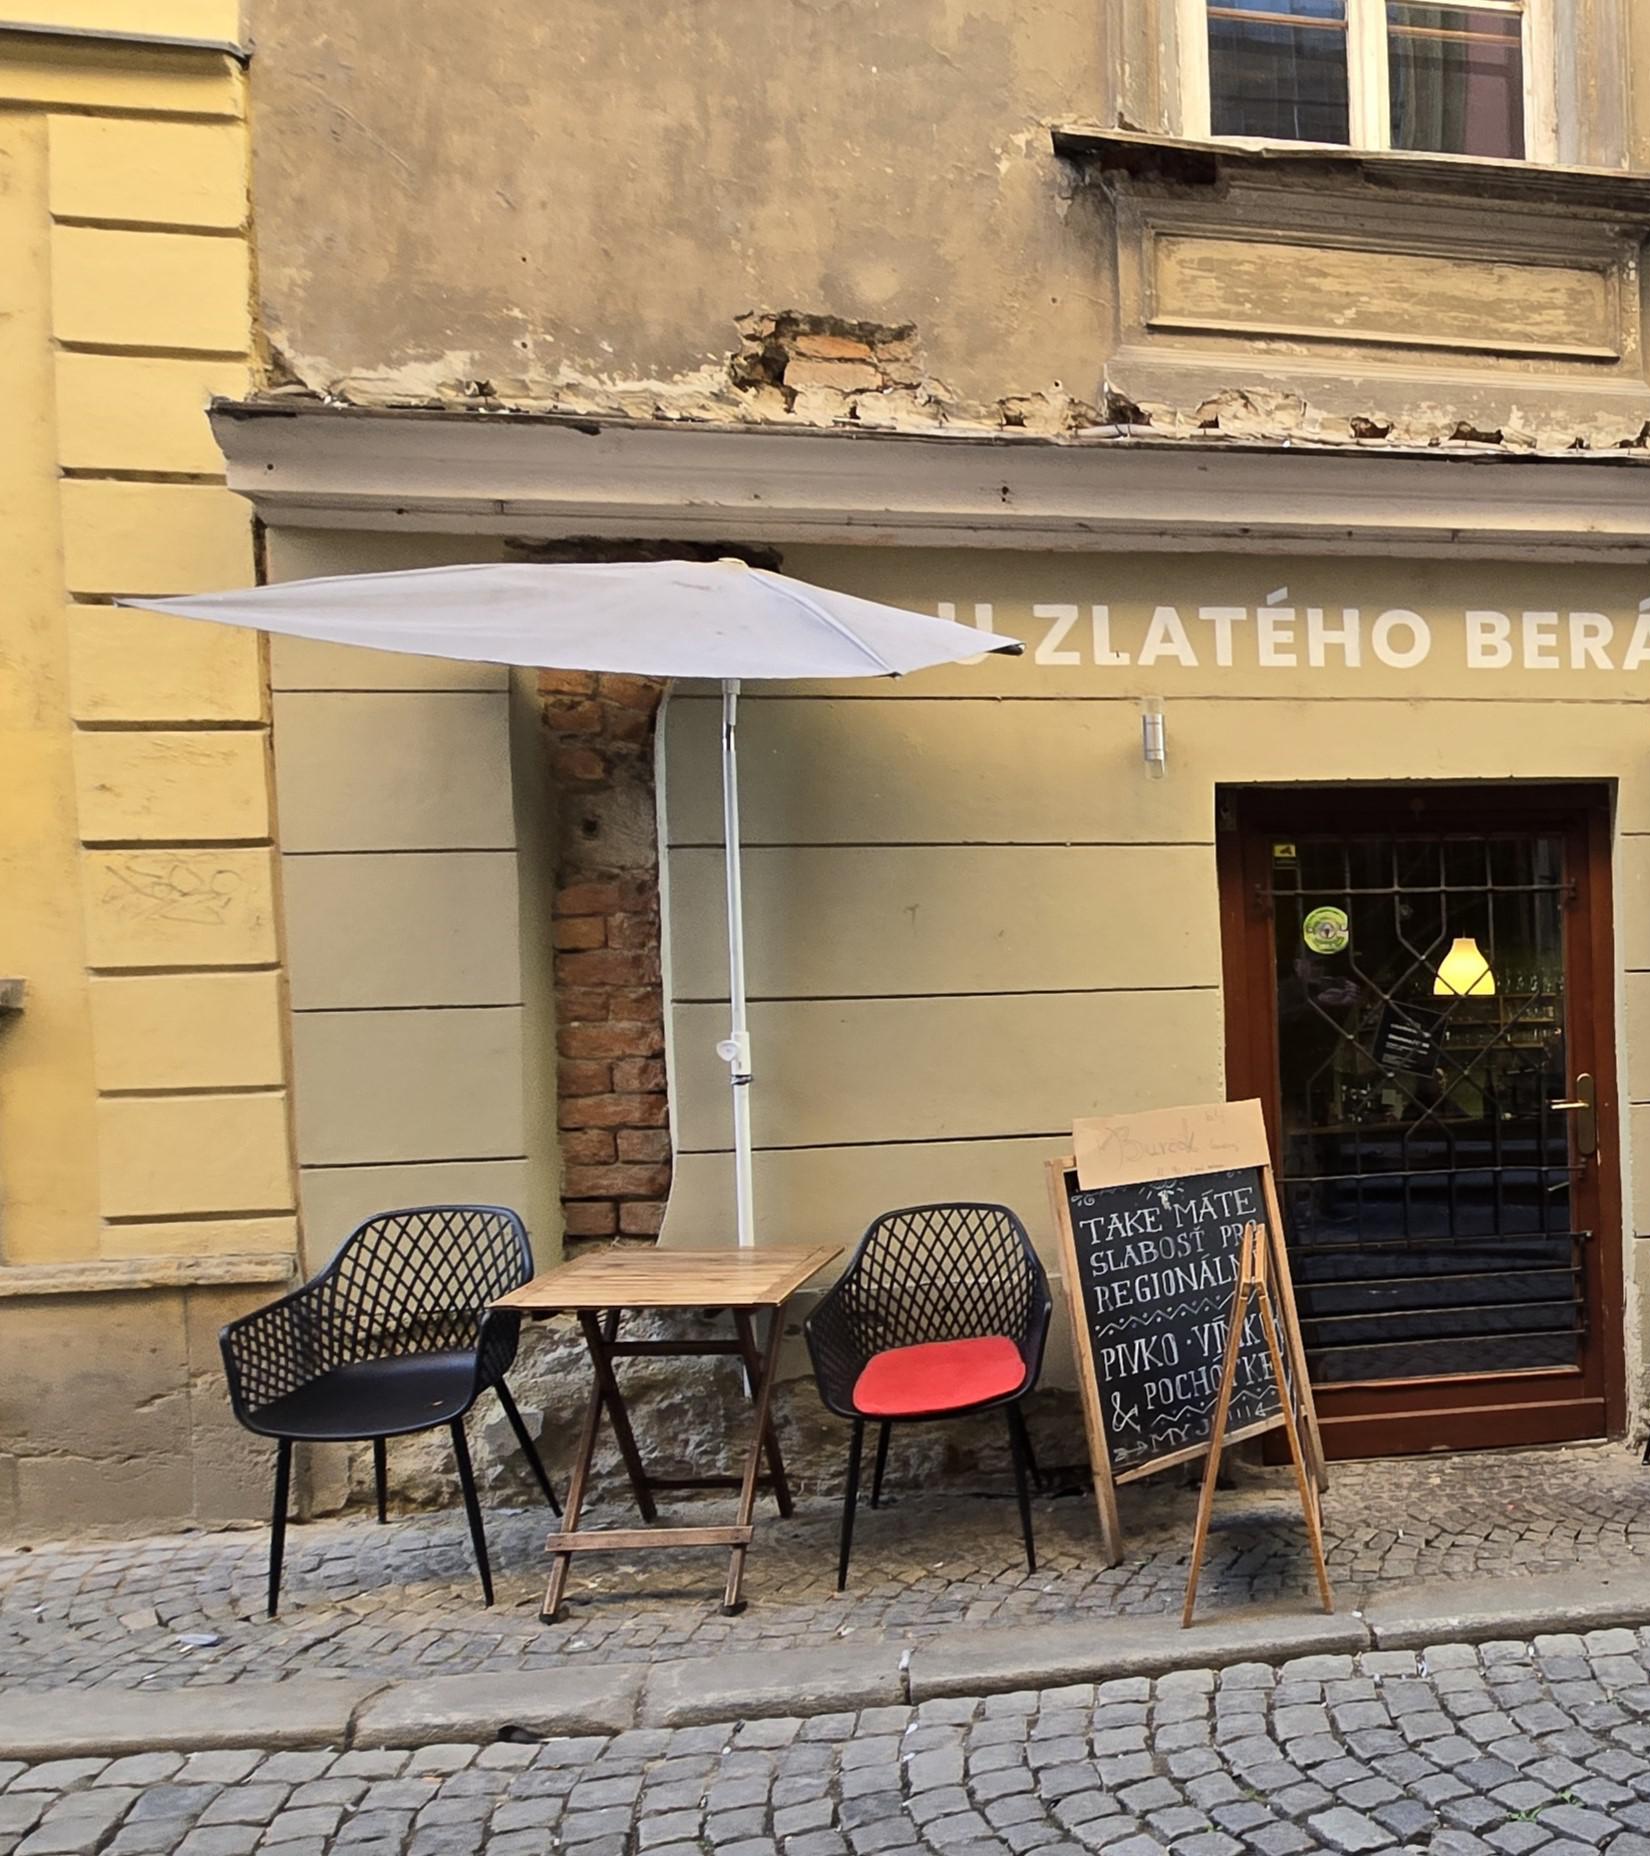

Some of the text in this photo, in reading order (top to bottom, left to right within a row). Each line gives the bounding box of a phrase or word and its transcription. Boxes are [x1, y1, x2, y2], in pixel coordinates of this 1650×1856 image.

[1032, 586, 1432, 668] ZLATÉHO
[1173, 1187, 1257, 1228] MÁTE
[1094, 1253, 1241, 1314] REGIONÁLN
[1101, 1333, 1179, 1381] PIVKO
[1110, 1391, 1142, 1433] &
[1150, 1424, 1191, 1453] MY
